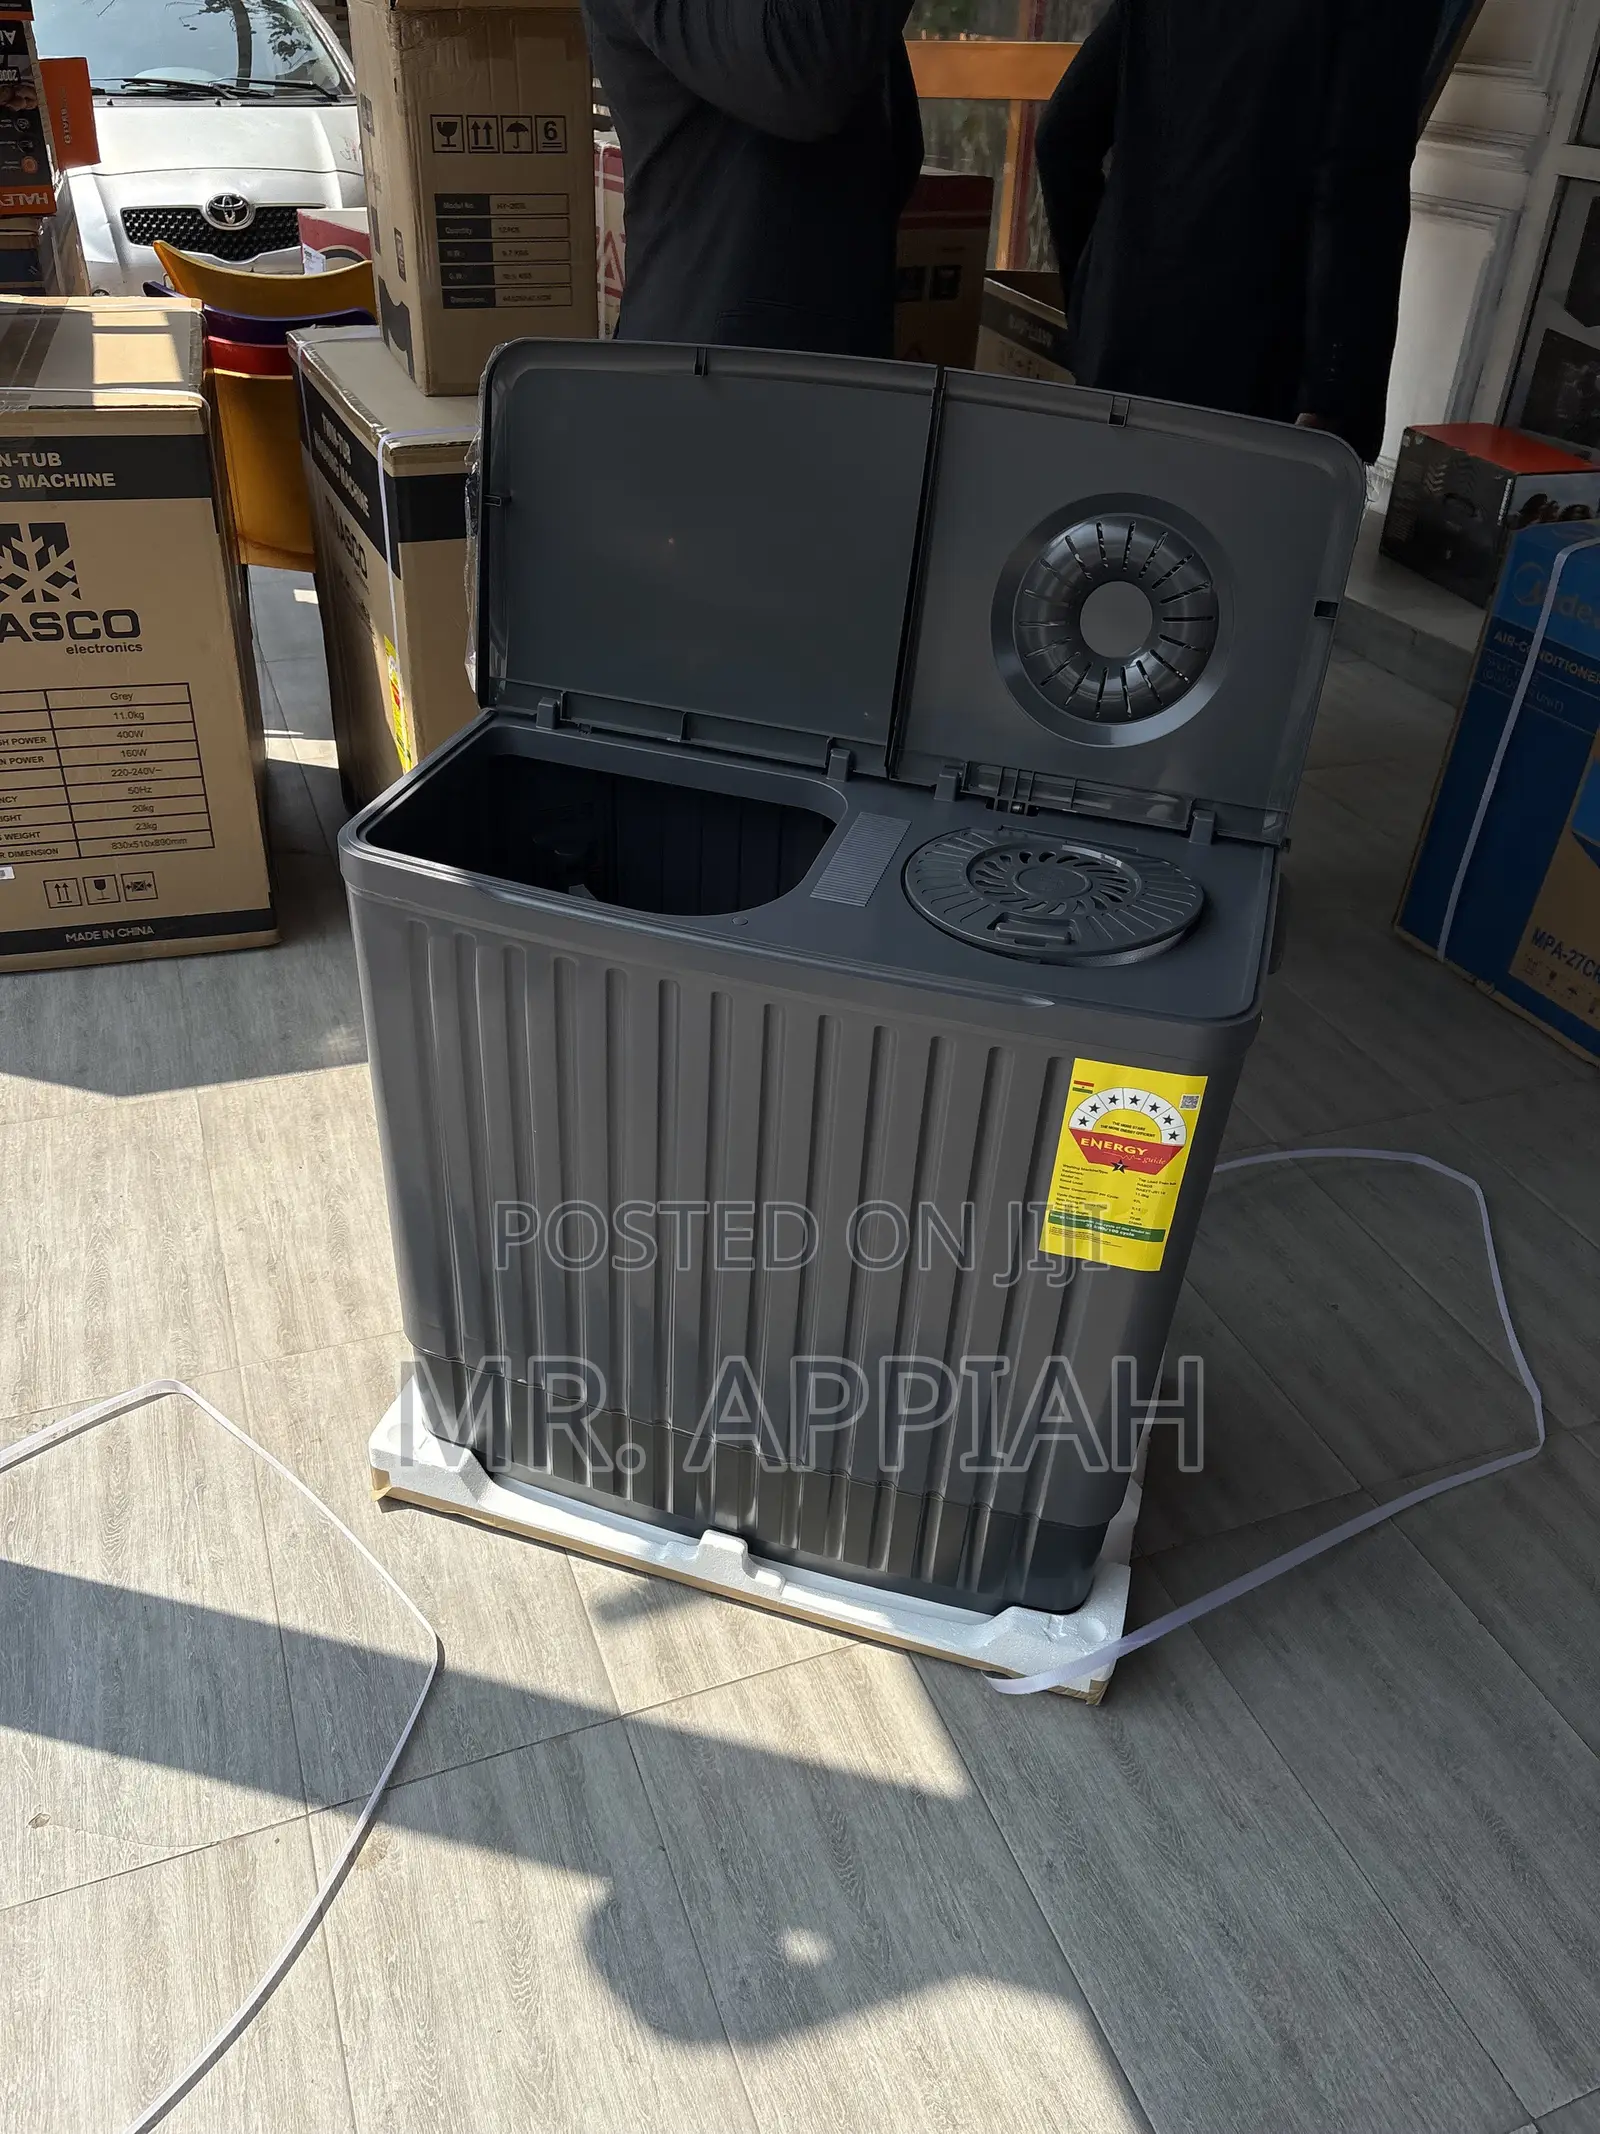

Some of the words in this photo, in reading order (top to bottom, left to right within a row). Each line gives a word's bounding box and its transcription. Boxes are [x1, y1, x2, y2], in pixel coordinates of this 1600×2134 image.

[0, 452, 62, 467] N-TUB
[18, 473, 116, 488] MACHINE
[66, 642, 143, 654] electronics
[1494, 631, 1600, 684] AIR-CNDITIONE
[110, 692, 134, 702] Grey
[113, 711, 144, 720] 11.0kg
[116, 730, 144, 738] 400W
[12, 736, 47, 745] POWER
[9, 756, 44, 764] POWER
[128, 786, 152, 794] 50Hz
[132, 804, 154, 813] 20kg
[136, 822, 157, 830] 23kg
[5, 832, 40, 840] WEIGHT
[8, 848, 58, 858] DIMENSION
[65, 930, 101, 942] MADE
[102, 929, 115, 938] IN
[117, 926, 155, 937] CHINA
[1081, 1138, 1148, 1155] ENERGY
[1142, 1156, 1166, 1165] guide
